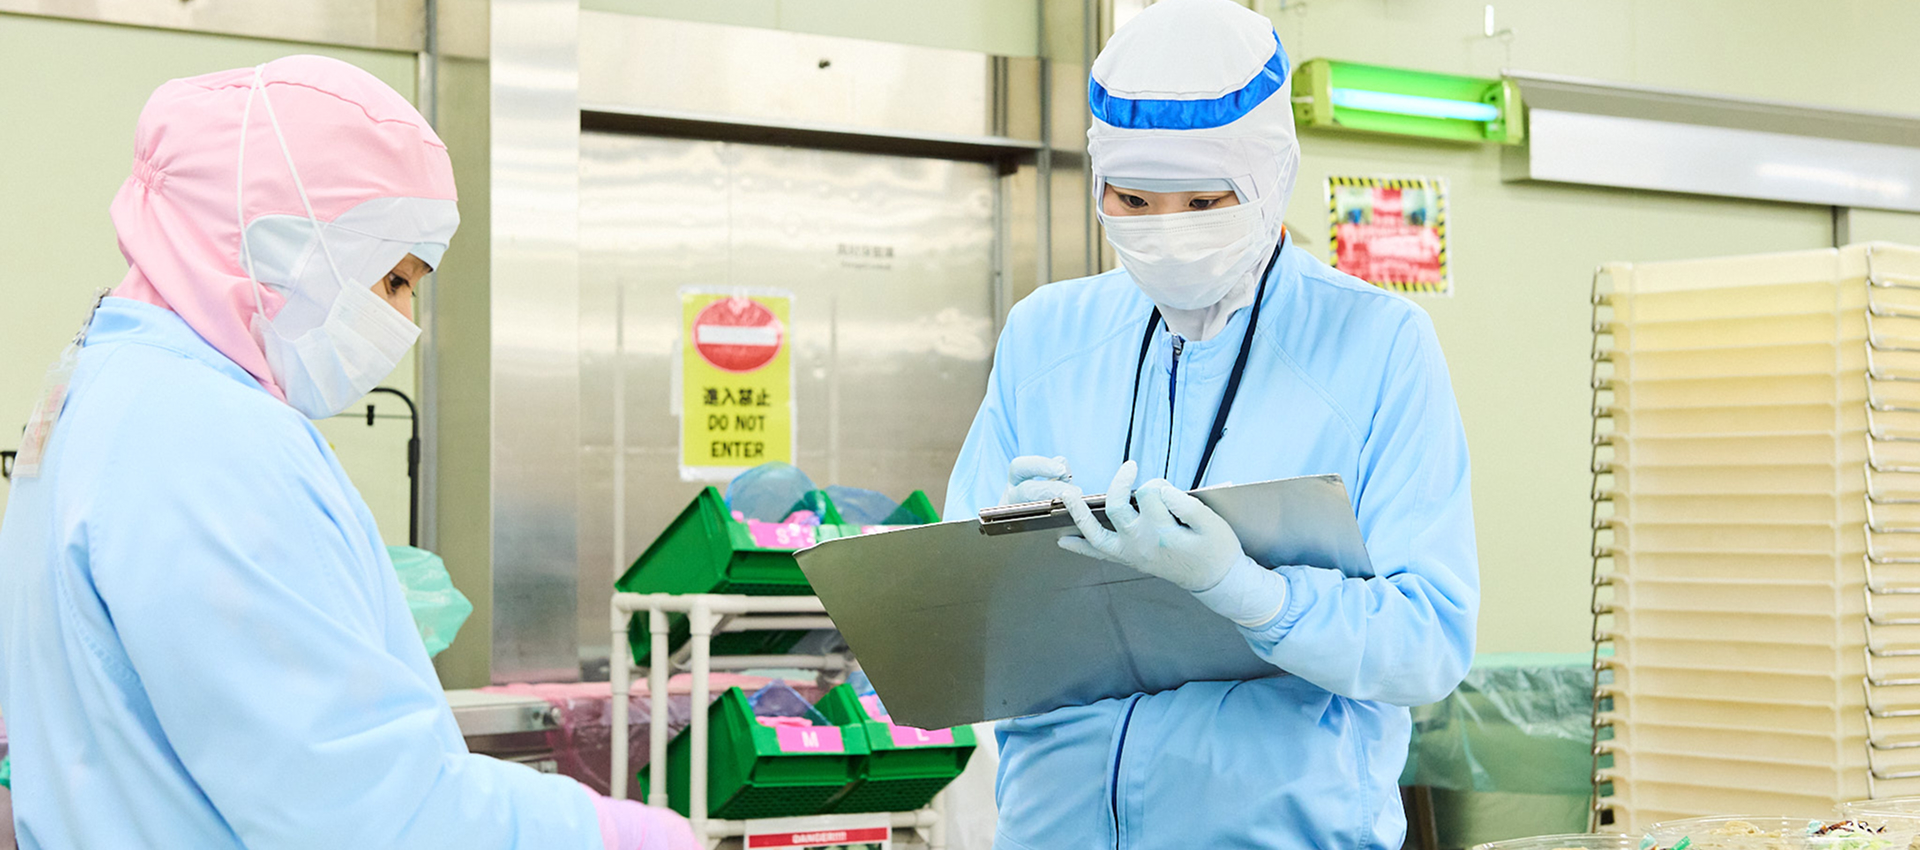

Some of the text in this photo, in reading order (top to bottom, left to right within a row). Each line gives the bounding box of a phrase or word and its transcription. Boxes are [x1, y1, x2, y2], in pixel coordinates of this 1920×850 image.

[703, 387, 771, 406] 進入禁止
[708, 414, 765, 431] DO NOT
[711, 441, 764, 458] ENTER
[801, 731, 820, 748] M
[914, 727, 930, 741] L
